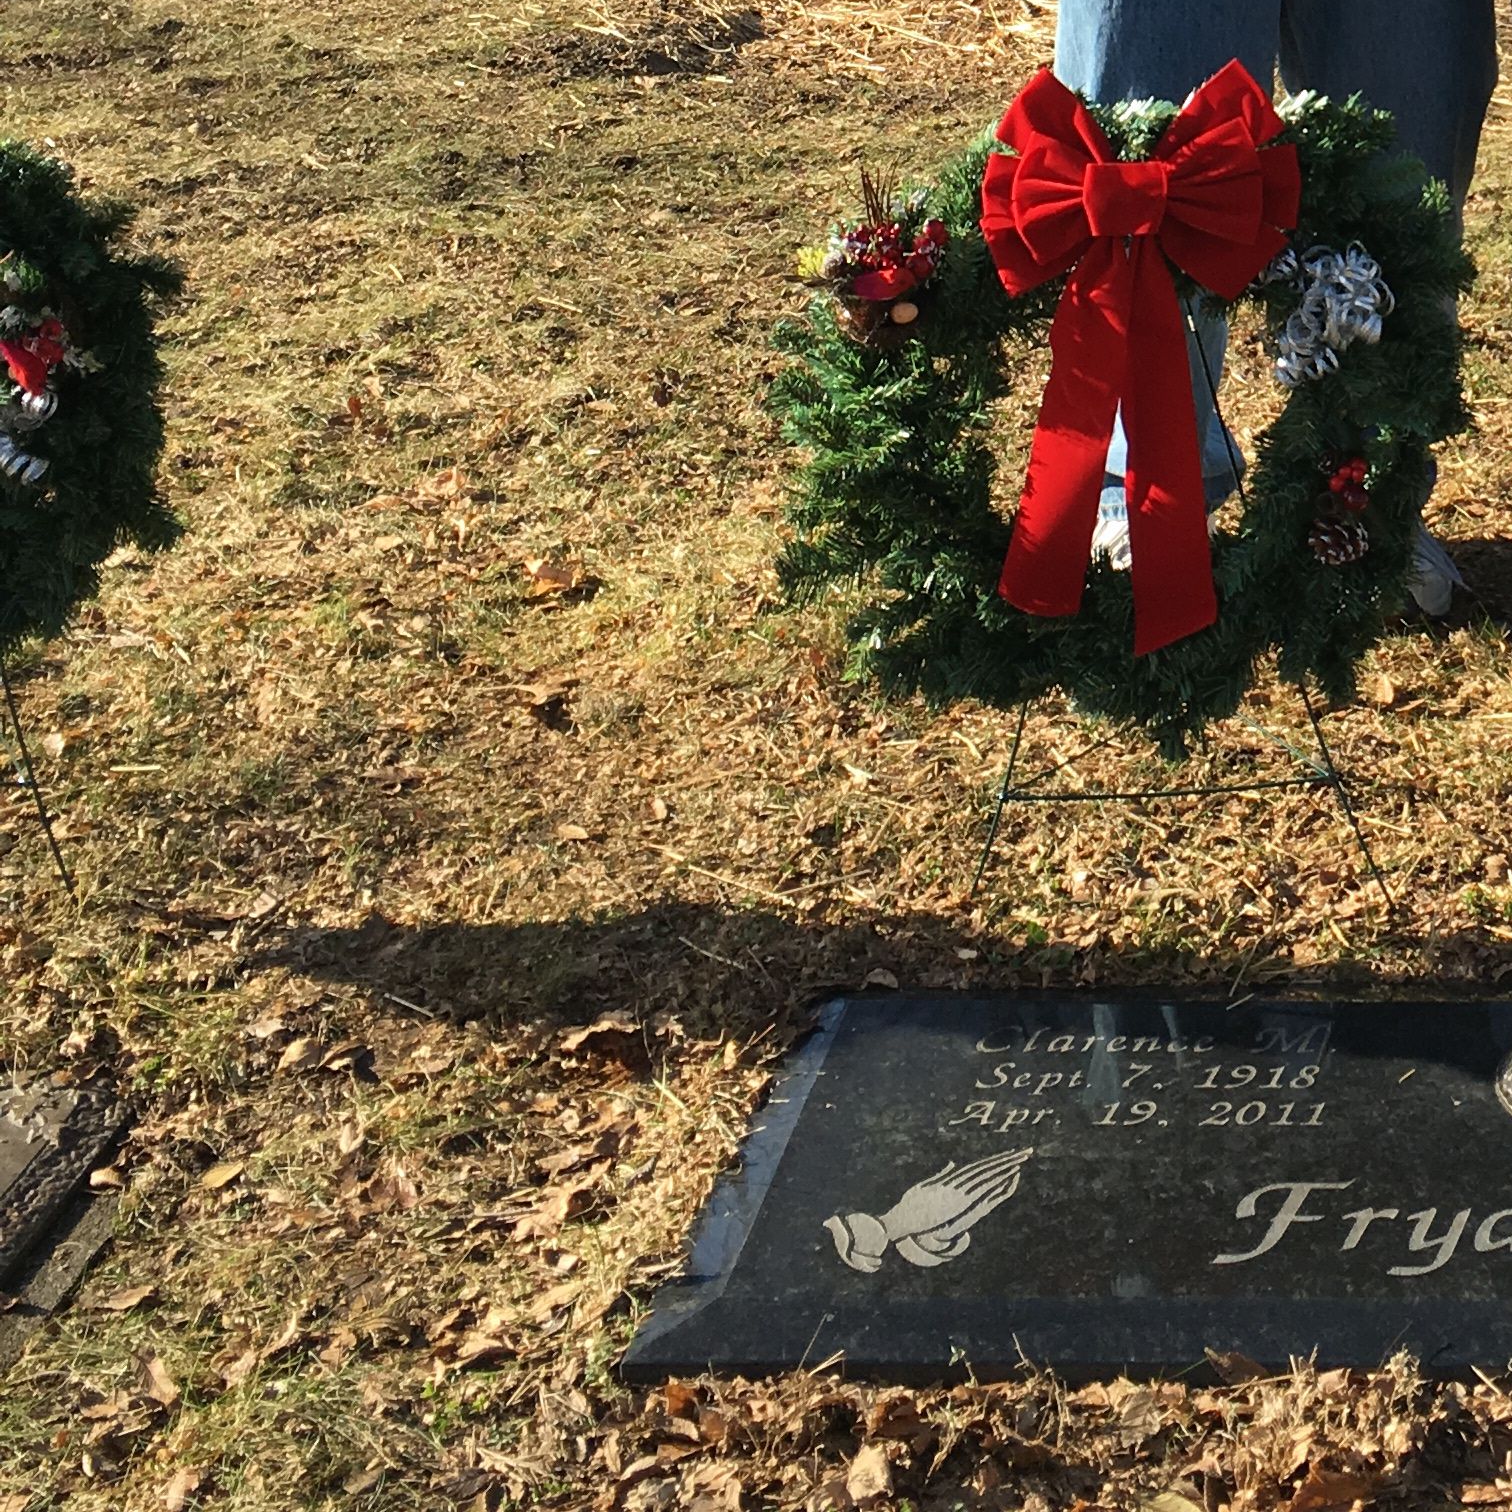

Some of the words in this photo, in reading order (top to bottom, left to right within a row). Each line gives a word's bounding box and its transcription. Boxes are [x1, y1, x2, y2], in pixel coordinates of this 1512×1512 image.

[975, 1025, 1214, 1053] Clarence
[975, 1062, 1092, 1096] Sept.
[1122, 1062, 1164, 1090] 7,
[1193, 1064, 1320, 1089] 1918
[949, 1100, 1062, 1133] Apr.
[1091, 1100, 1168, 1128] 19,
[1198, 1100, 1326, 1127] 2011
